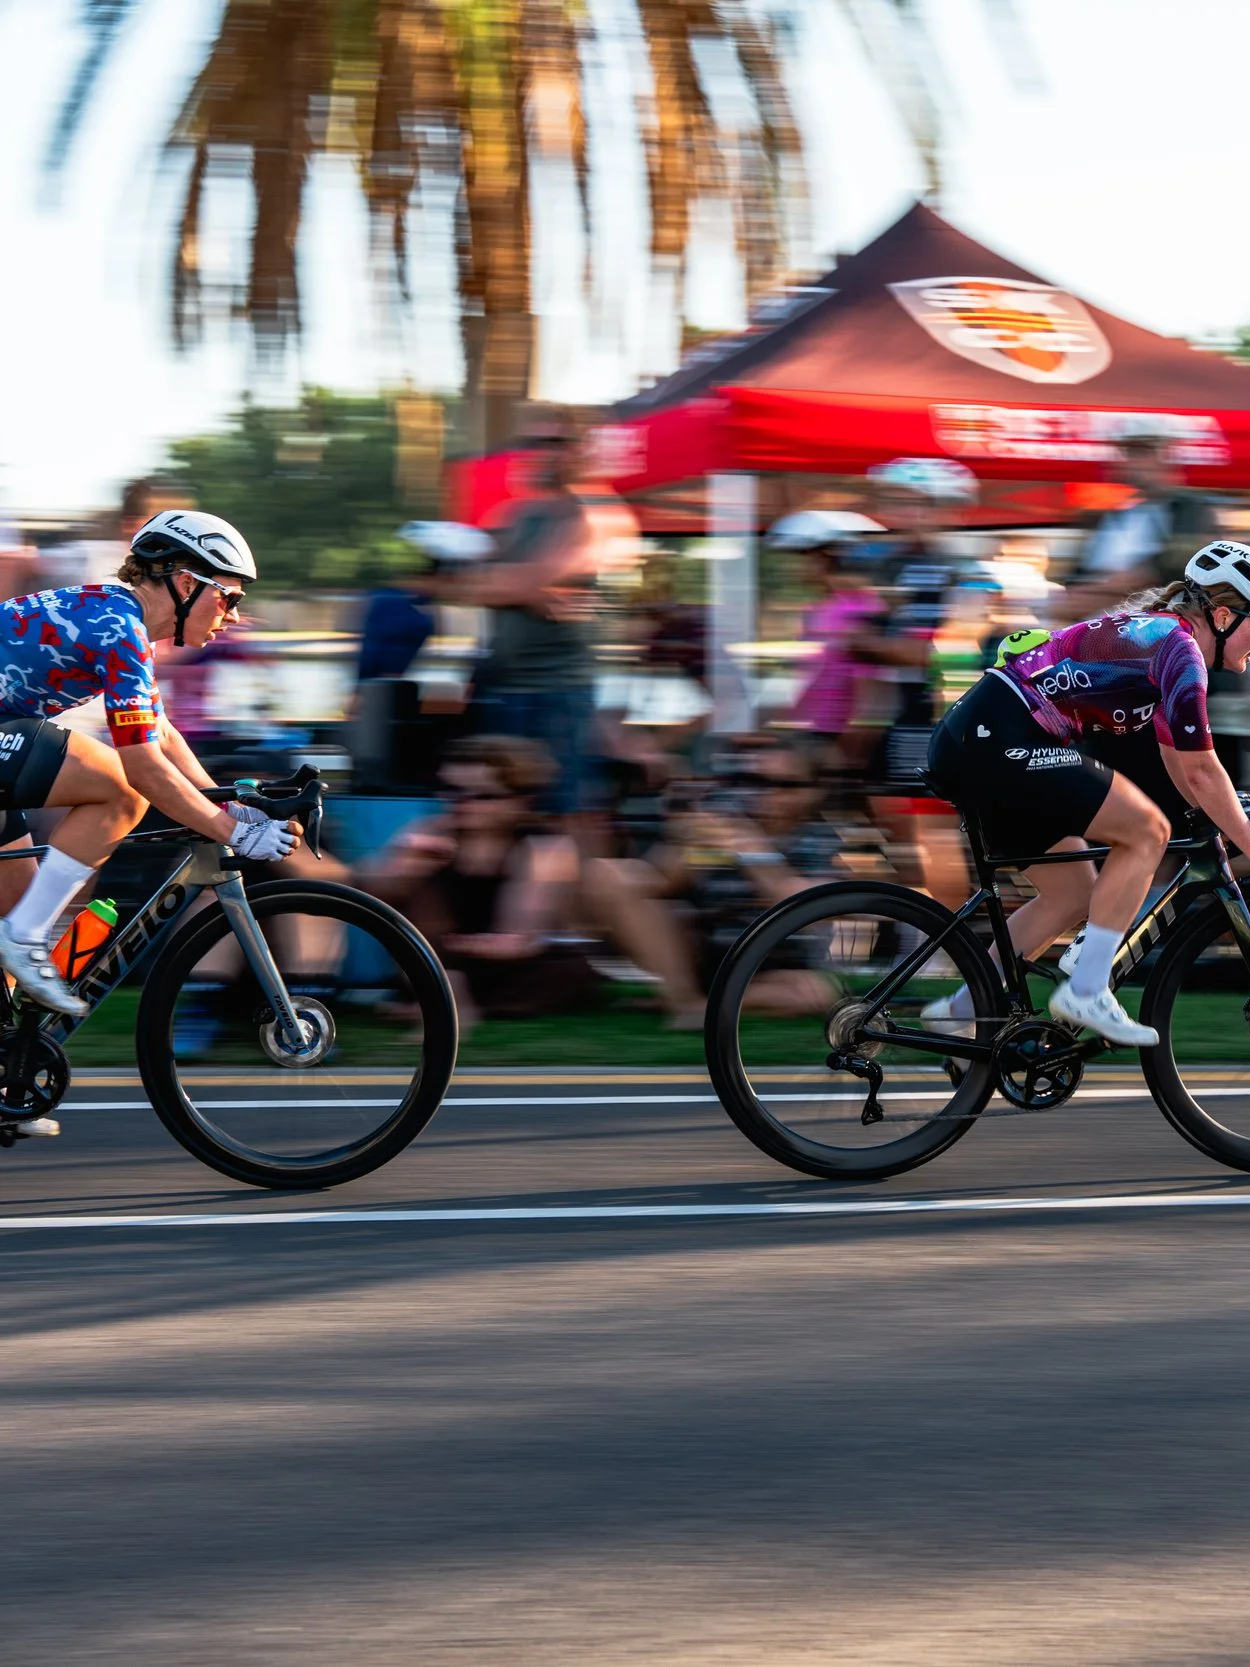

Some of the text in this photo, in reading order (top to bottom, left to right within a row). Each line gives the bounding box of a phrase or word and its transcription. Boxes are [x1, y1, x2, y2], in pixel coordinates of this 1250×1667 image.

[167, 524, 198, 542] LAZER
[1217, 543, 1250, 559] KASK
[1028, 754, 1082, 766] ESSENDON
